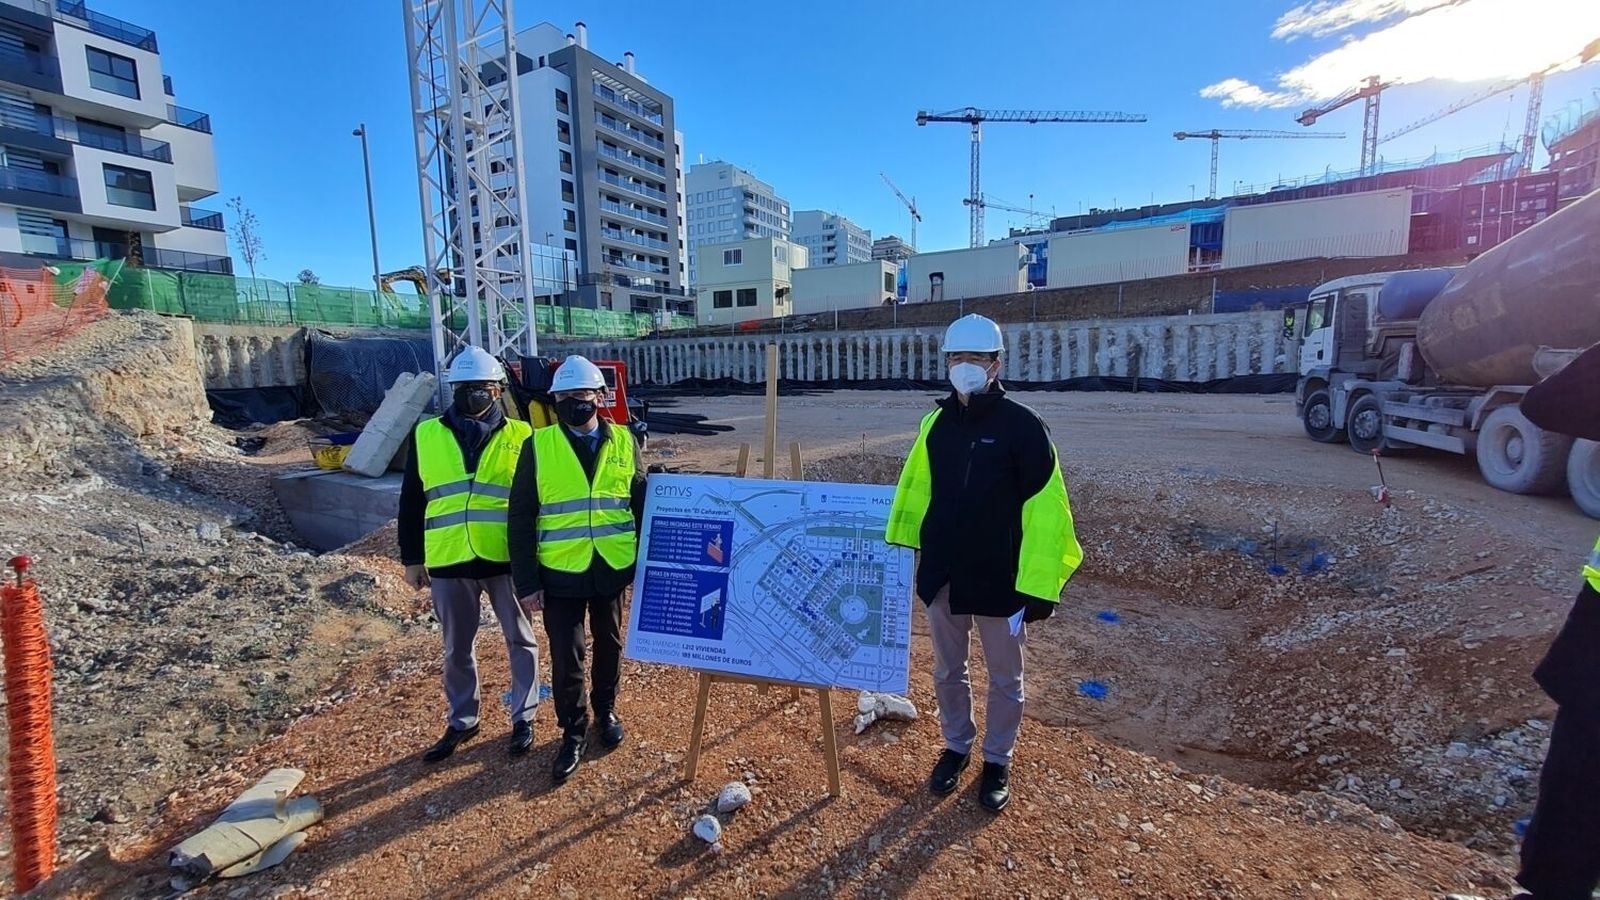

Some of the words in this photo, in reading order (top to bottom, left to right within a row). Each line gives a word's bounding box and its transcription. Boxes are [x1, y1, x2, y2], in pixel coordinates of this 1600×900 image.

[655, 484, 692, 498] emvs
[696, 645, 726, 654] VIVIENDAS
[692, 654, 721, 662] MILLONES
